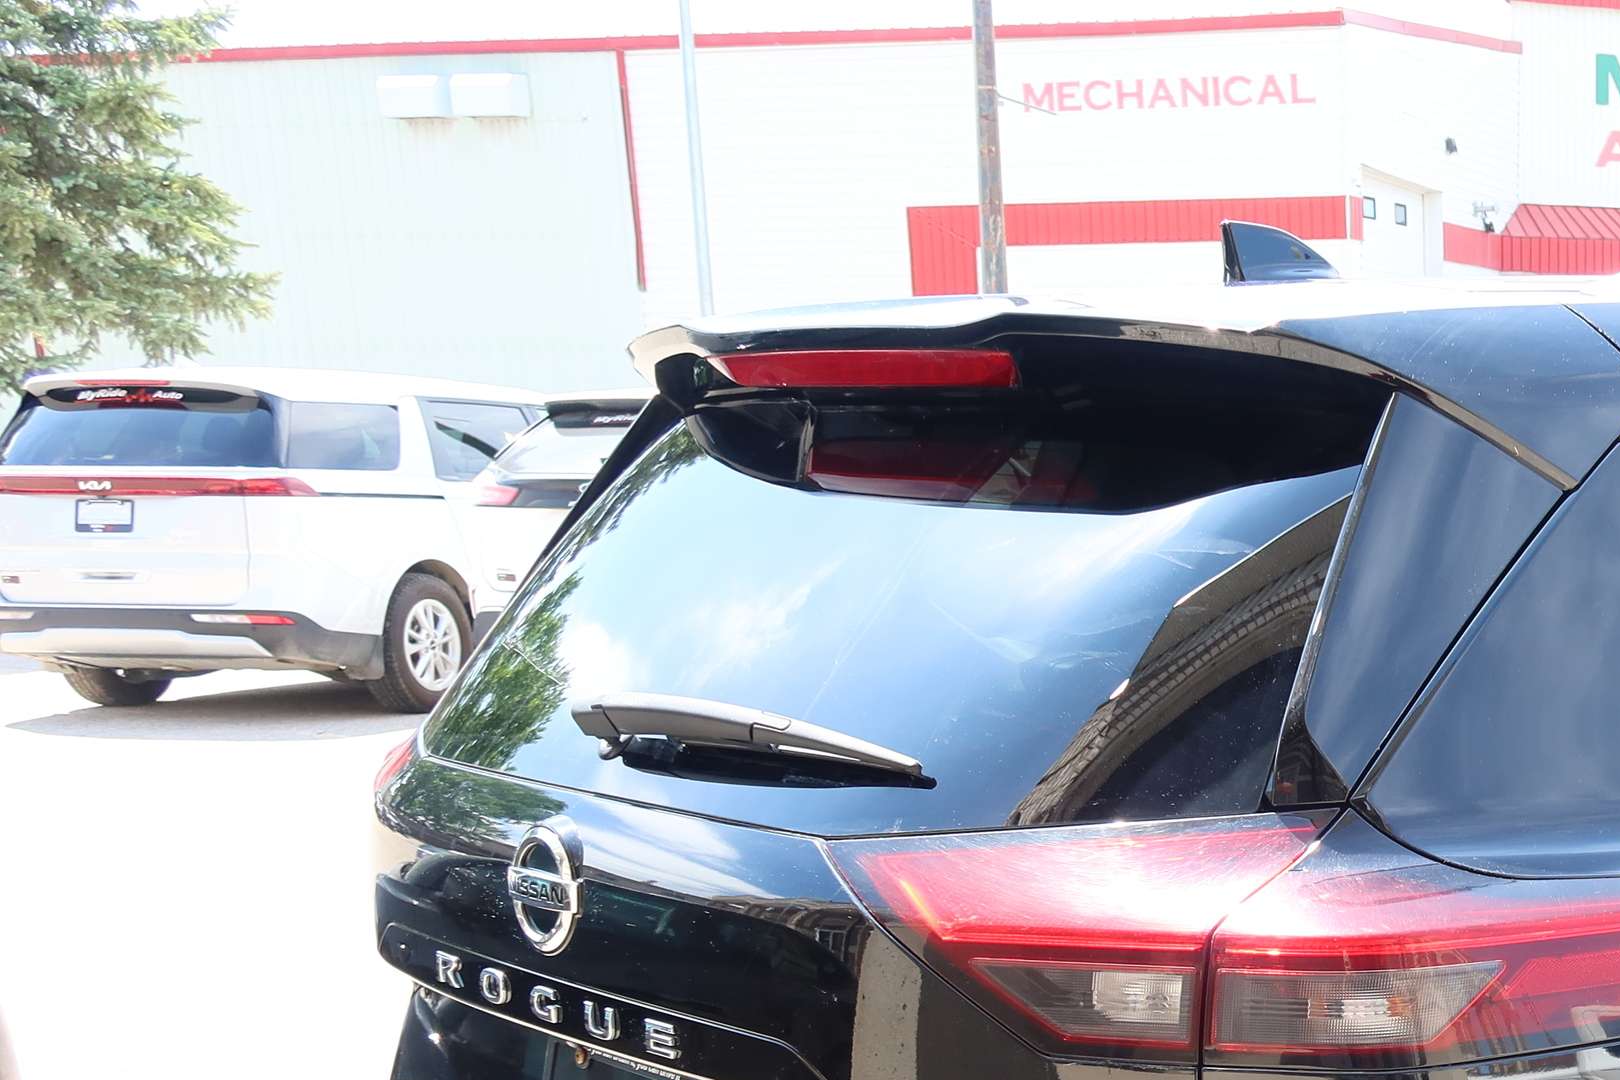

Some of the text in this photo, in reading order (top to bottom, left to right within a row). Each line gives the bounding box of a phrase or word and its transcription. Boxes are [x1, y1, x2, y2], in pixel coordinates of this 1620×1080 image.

[1021, 73, 1317, 113] MECHANICAL
[152, 390, 184, 400] Auto
[509, 872, 567, 907] NISSAN
[434, 949, 682, 1060] ROGUE
